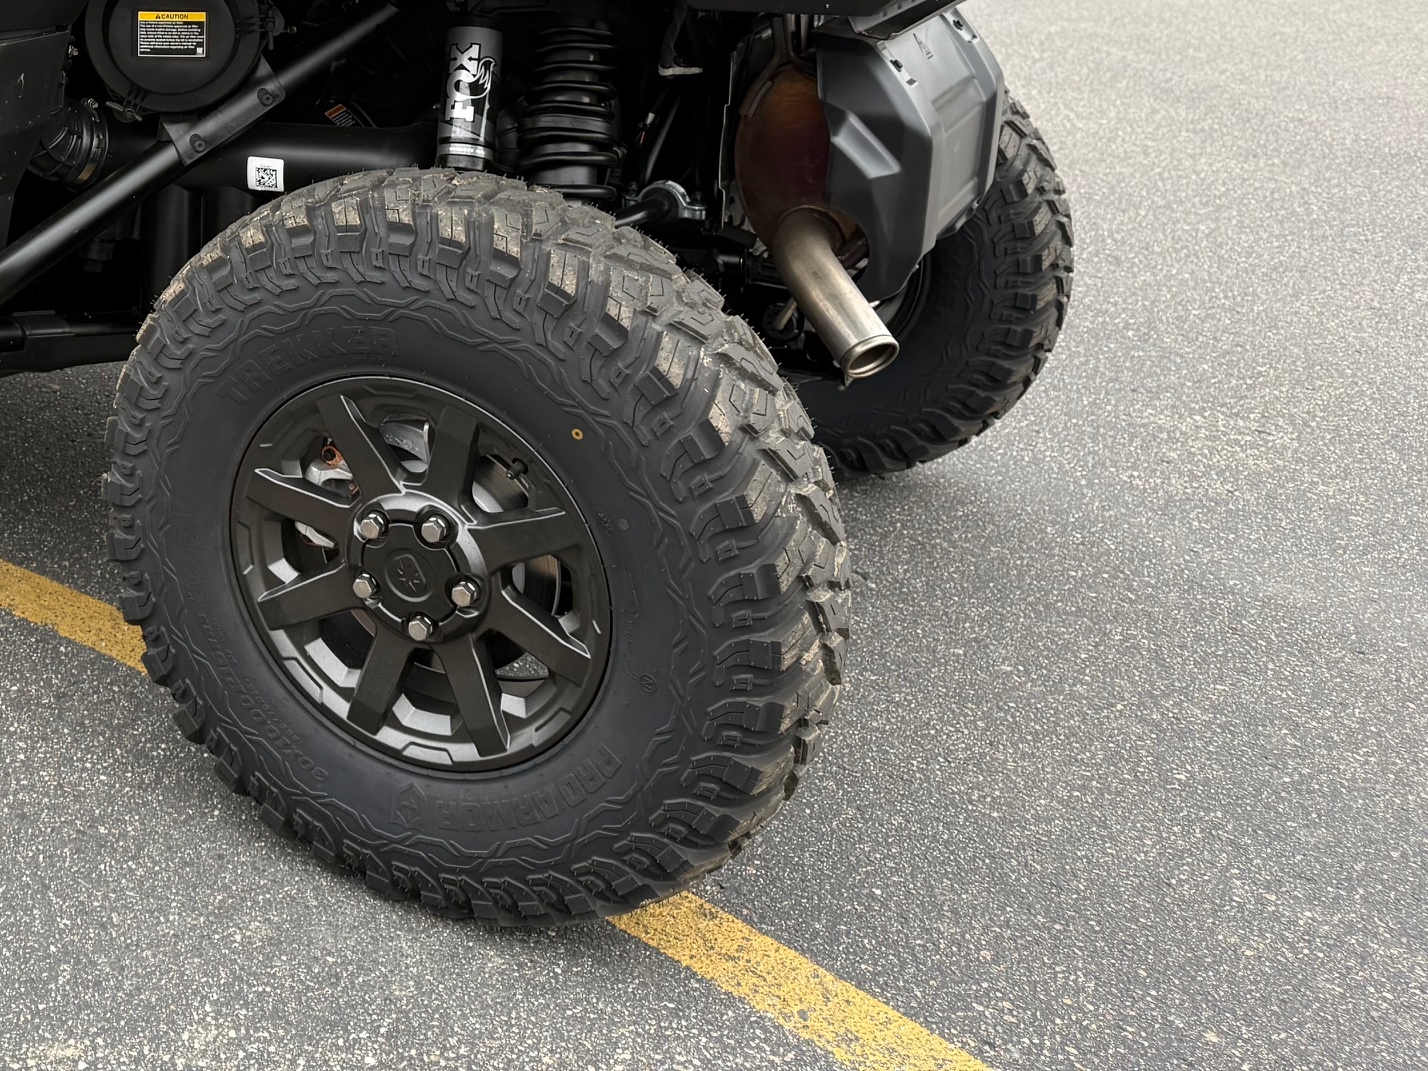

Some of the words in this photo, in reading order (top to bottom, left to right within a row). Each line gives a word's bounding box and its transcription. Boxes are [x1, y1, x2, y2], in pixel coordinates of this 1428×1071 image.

[444, 42, 487, 122] FOX
[215, 325, 399, 406] TREKKER
[434, 786, 560, 832] ARMOR
[555, 742, 623, 808] PRO
